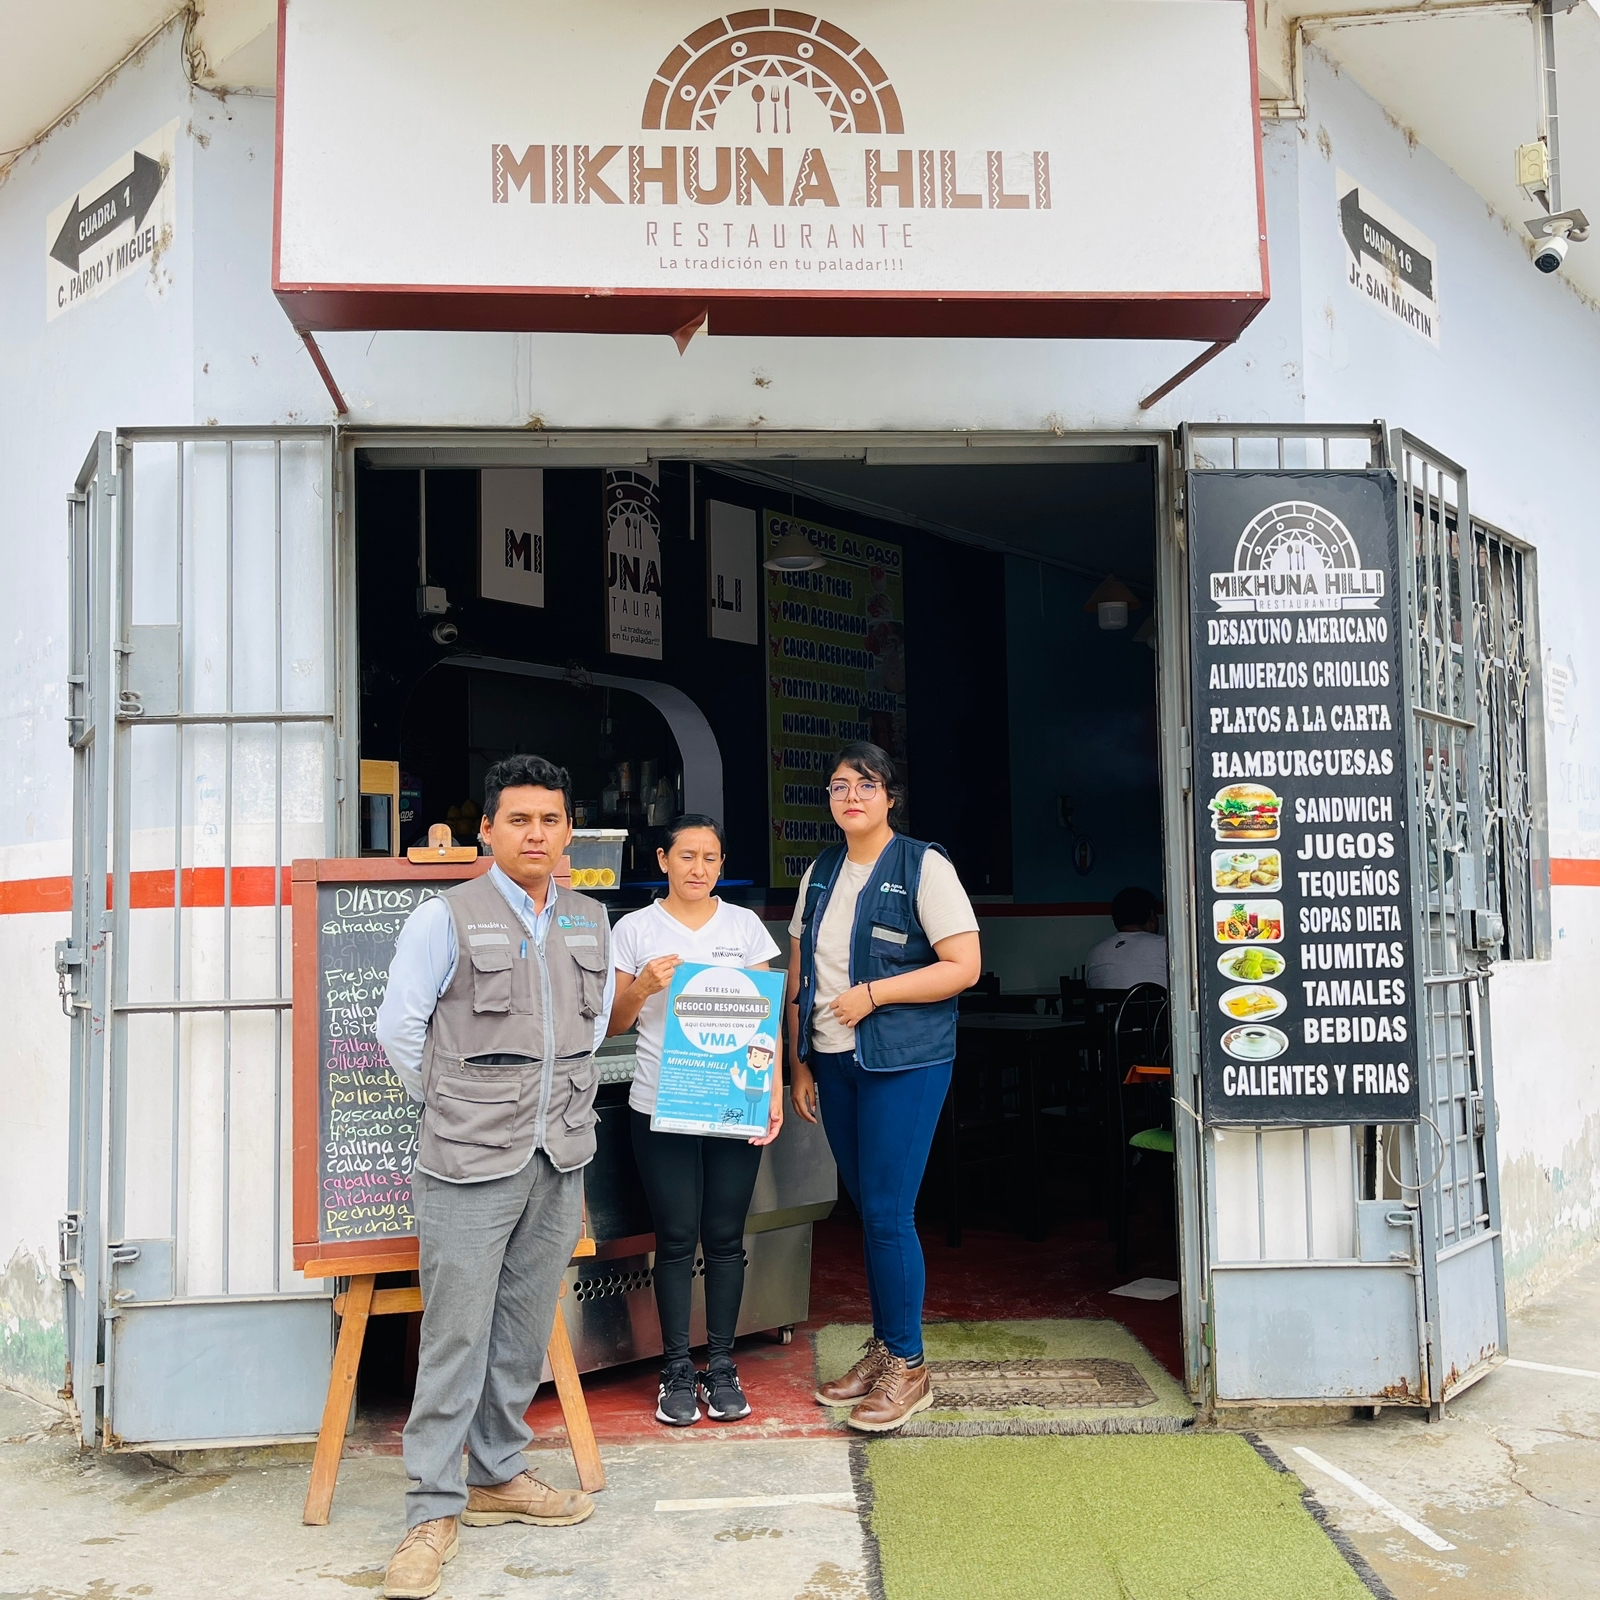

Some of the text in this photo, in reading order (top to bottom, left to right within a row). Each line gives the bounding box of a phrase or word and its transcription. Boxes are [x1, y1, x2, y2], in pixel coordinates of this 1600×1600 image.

[491, 143, 1052, 210] MIKHUNA HILLI
[78, 185, 131, 242] CUADRA 1
[646, 221, 914, 249] RESTAURANTE
[1363, 222, 1412, 273] CUADRA 16
[57, 225, 158, 308] C. PARDO Y MIGUEL
[659, 254, 904, 273] La tradición en tu paladar!!!
[1349, 262, 1432, 338] Jr. SAN MARTIN
[505, 527, 542, 574] MI
[769, 518, 901, 567] CECHE AL PASO
[781, 571, 853, 600] LECHE DE TIGRE
[1213, 571, 1382, 598] MIKHUNA HILLI
[611, 596, 660, 620] TAURA
[1260, 597, 1339, 610] RESTAURANTE
[628, 626, 652, 637] tradición
[782, 600, 868, 637] PAPA ACEBICHADA
[1207, 615, 1389, 646] DESAYUNO AMERICANO
[612, 632, 621, 640] en
[622, 632, 630, 641] tu
[783, 636, 875, 671] CAUSA ACEBICHADA
[1208, 660, 1390, 690] ALMUERZOS CRIOLLOS
[781, 676, 818, 702] TORTITA
[819, 682, 829, 704] DE
[830, 684, 861, 708] CHOCLO
[867, 690, 898, 713] CEBICHE
[781, 712, 831, 738] HUANCAINA
[838, 719, 870, 742] CEBICHE
[1209, 704, 1393, 734] PLATOS A LA CARTA
[783, 748, 812, 771] ARROZ
[1211, 748, 1395, 778] HAMBURGUESAS
[400, 810, 414, 822] ape
[1294, 796, 1393, 823] SANDWICH
[784, 820, 818, 842] CEBICHE
[1296, 831, 1395, 860] JUGOS
[1297, 864, 1401, 900] TEQUEÑOS
[1299, 905, 1402, 934] SOPAS DIETA
[1300, 941, 1405, 970] HUMITAS
[1302, 977, 1406, 1007] TAMALES
[676, 1001, 769, 1013] NEGOCIO RESPONSABLE
[698, 1032, 738, 1047] VMA
[1303, 1015, 1408, 1044] BEBIDAS
[667, 1056, 729, 1071] MIKHUNA HILLI
[1222, 1062, 1411, 1096] CALIENTES Y FRIAS
[326, 1155, 373, 1174] caldo
[375, 1154, 399, 1171] de
